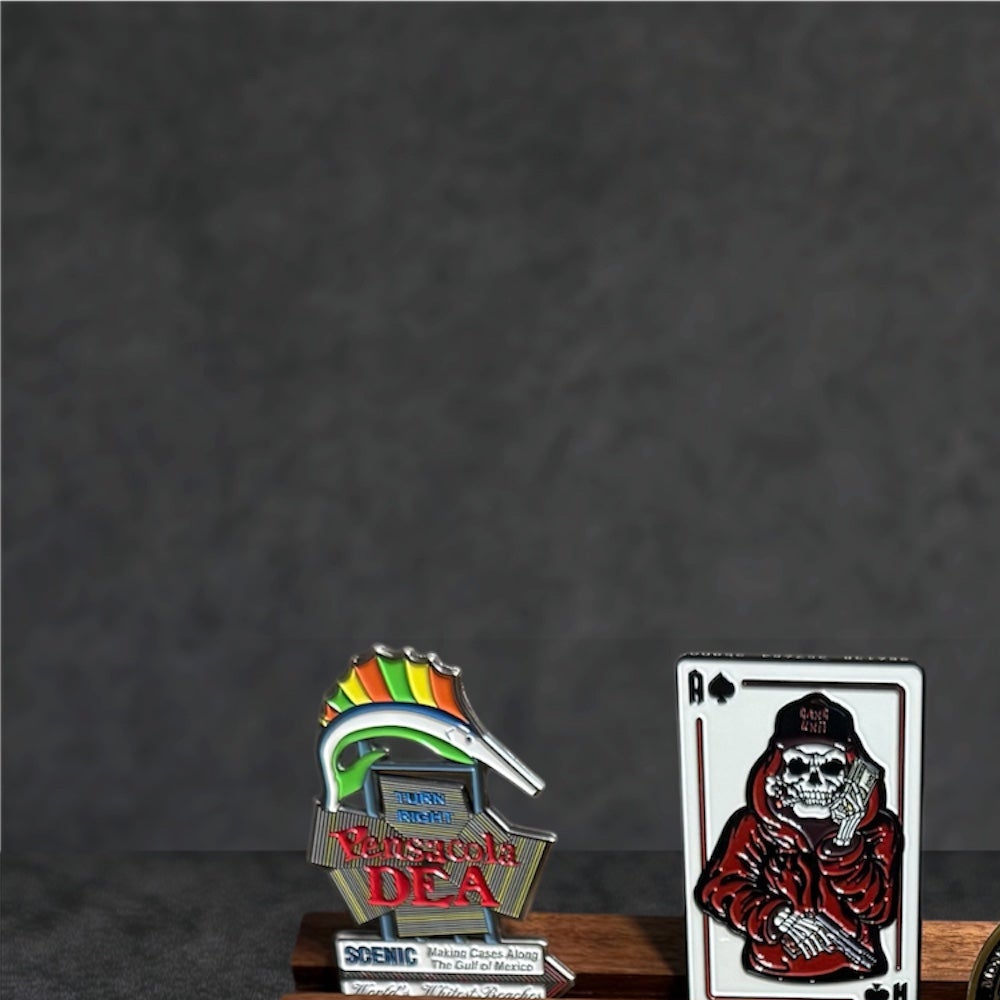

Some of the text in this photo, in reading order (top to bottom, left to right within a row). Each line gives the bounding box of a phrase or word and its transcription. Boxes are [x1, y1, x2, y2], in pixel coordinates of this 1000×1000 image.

[688, 670, 704, 705] A
[394, 790, 446, 805] TURN
[396, 809, 453, 824] RIGHT
[330, 826, 520, 867] Pensacola
[364, 865, 500, 908] DEA
[345, 946, 418, 967] SCENIC
[428, 947, 539, 961] Making Cases Along
[432, 960, 534, 972] The Gulf of Mexico
